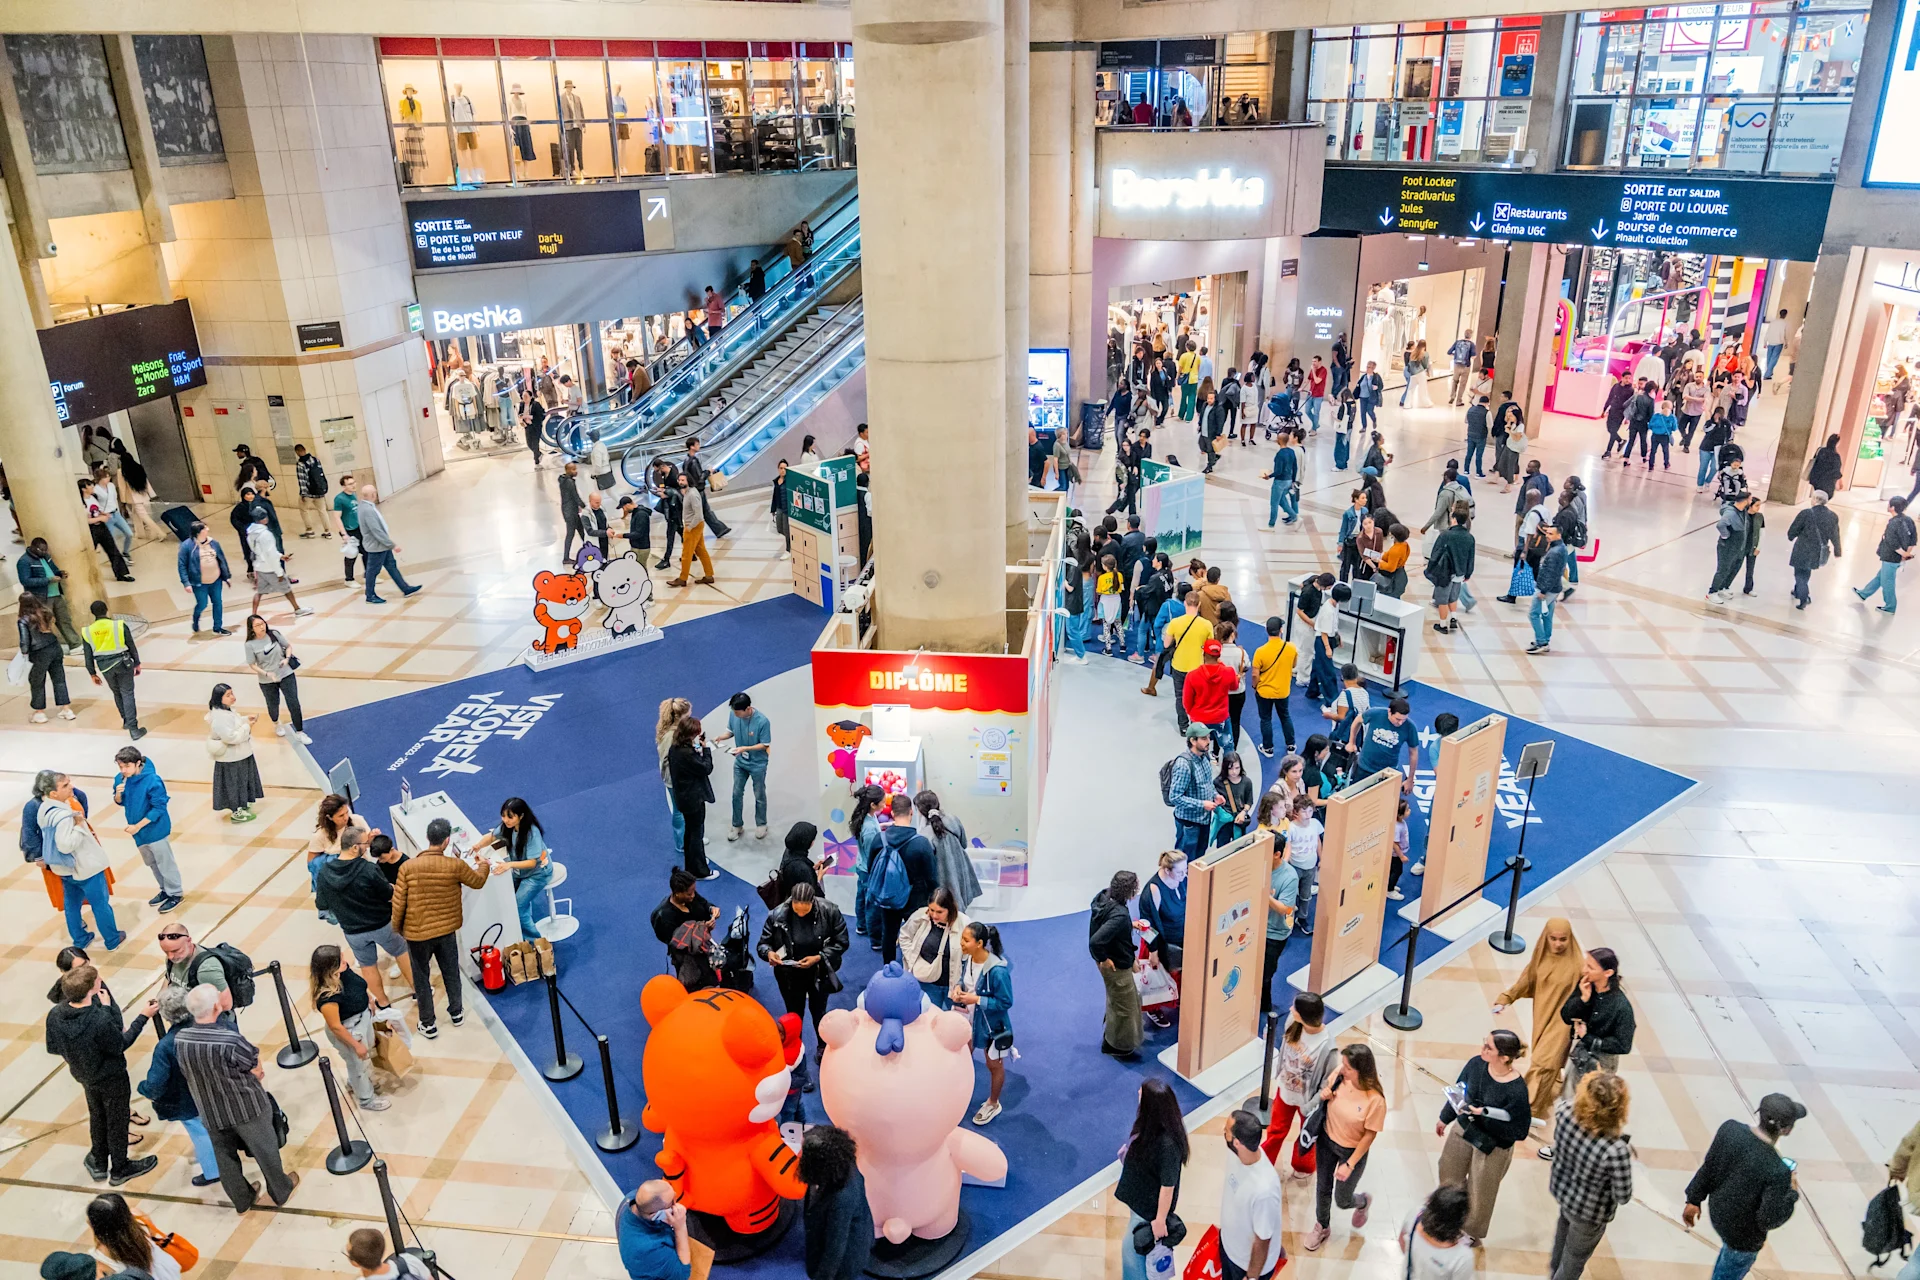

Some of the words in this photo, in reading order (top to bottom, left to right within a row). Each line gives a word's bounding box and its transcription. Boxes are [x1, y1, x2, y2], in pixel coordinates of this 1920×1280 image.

[1112, 167, 1265, 208] Bershka
[1402, 176, 1423, 187] Foot
[1425, 177, 1457, 188] Locker
[1401, 190, 1456, 202] Stradivarius
[1623, 183, 1666, 196] SORTIE
[1667, 188, 1688, 197] EXIT
[1689, 189, 1721, 198] SALIDA
[1399, 203, 1424, 214] Jules
[1622, 199, 1629, 210] 8
[1634, 201, 1667, 212] PORTE
[1669, 202, 1684, 213] DU
[1687, 203, 1730, 215] LOUVRE
[1510, 208, 1568, 220] Restaurants
[1632, 212, 1660, 222] Jardin
[414, 219, 453, 232] SORTIE
[1398, 218, 1439, 231] Jennyfer
[1528, 226, 1546, 236] UGC
[1617, 221, 1656, 233] Bourse
[1658, 222, 1674, 234] de
[1676, 225, 1738, 238] commerce
[418, 236, 426, 247] 6
[429, 234, 460, 245] PORTE
[473, 232, 498, 242] PONT
[500, 230, 523, 241] NEUF
[538, 232, 564, 245] Darty
[1615, 233, 1644, 243] Pinault
[1645, 235, 1689, 246] Collection
[442, 245, 452, 253] de
[453, 245, 461, 253] la
[461, 243, 475, 252] Cité
[539, 243, 558, 256] Muji
[432, 254, 446, 262] Rue
[447, 253, 457, 261] de
[457, 252, 477, 261] Rivoli
[1306, 306, 1342, 317] Bershka
[432, 304, 523, 334] Bershka
[168, 350, 187, 363] Fnac
[131, 358, 164, 375] Maisons
[171, 363, 182, 375] Go
[182, 356, 203, 373] Sport
[134, 374, 144, 385] du
[143, 366, 170, 383] Monde
[173, 374, 191, 387] H&M
[51, 386, 59, 398] P
[63, 381, 84, 393] Forum
[136, 384, 156, 398] Zara
[869, 668, 968, 693] DIPLÔME
[419, 691, 504, 743] YEAR
[494, 693, 564, 740] VISIT
[419, 704, 521, 779] KOREA
[386, 742, 425, 771] 2023-2024
